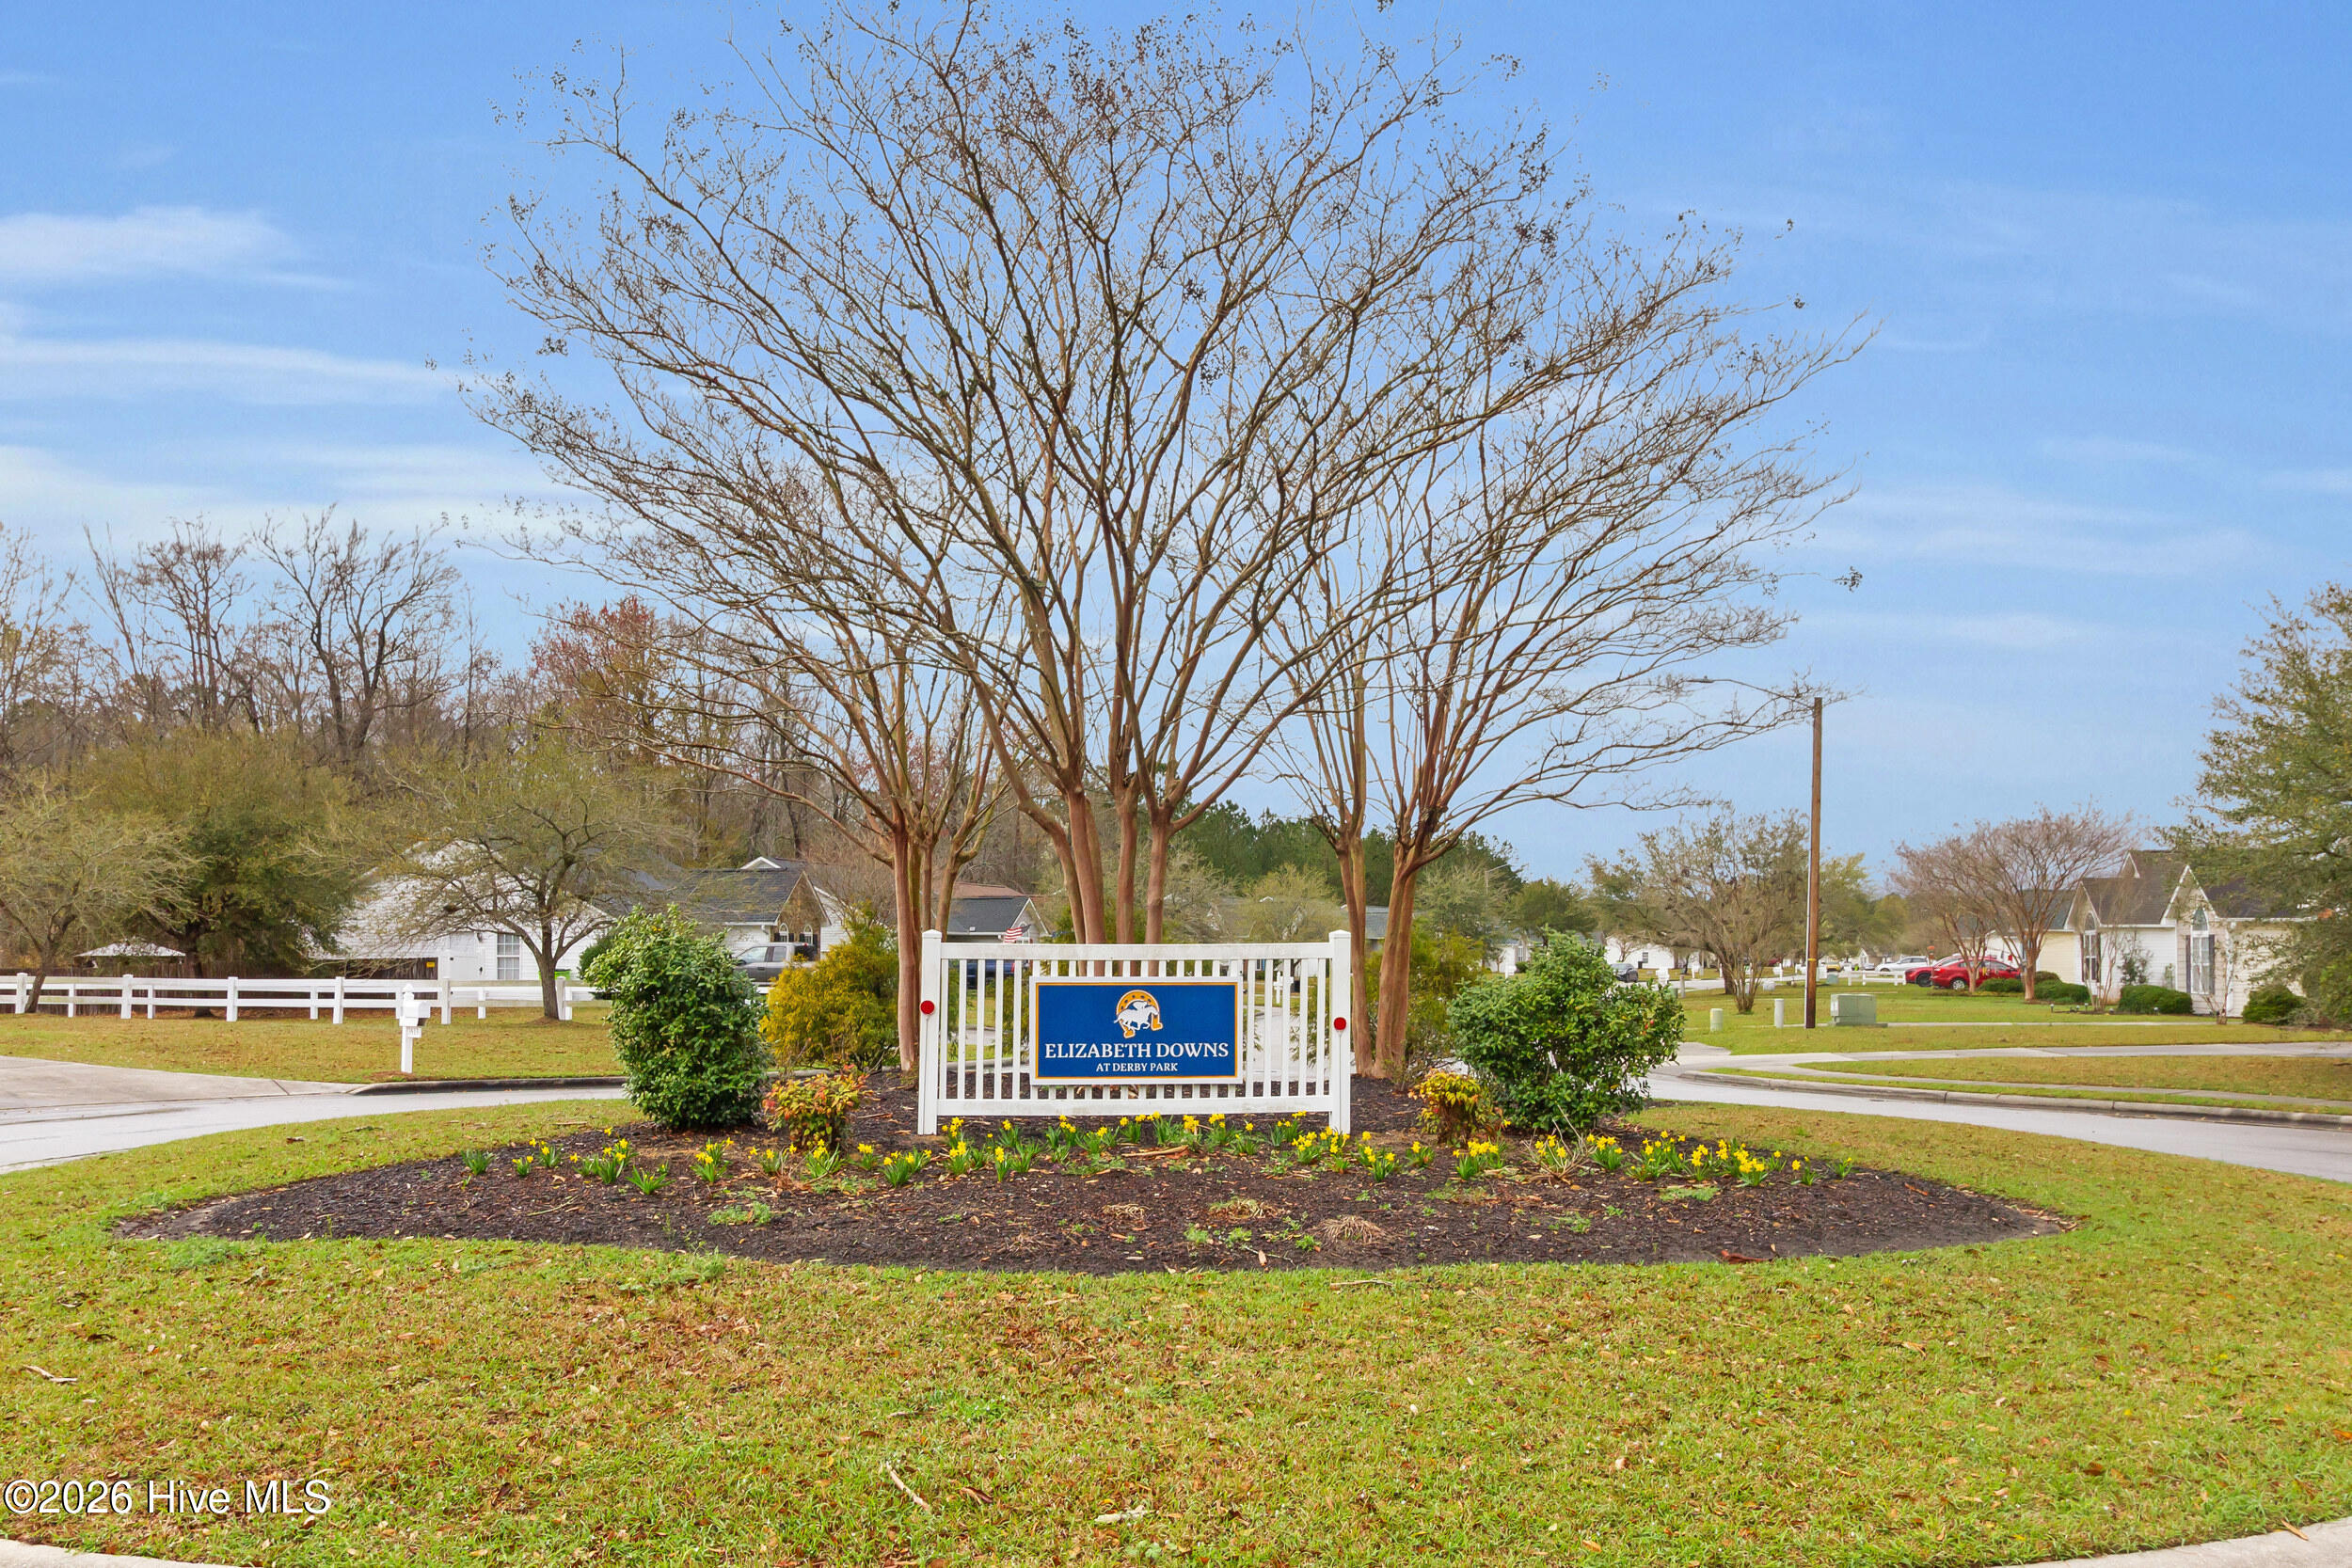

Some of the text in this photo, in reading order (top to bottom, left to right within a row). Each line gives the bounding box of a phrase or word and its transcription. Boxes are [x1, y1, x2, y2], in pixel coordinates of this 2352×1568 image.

[1044, 1042, 1229, 1058] ELIZABETH DOWNS
[1096, 1062, 1178, 1072] AT DERBY PARK
